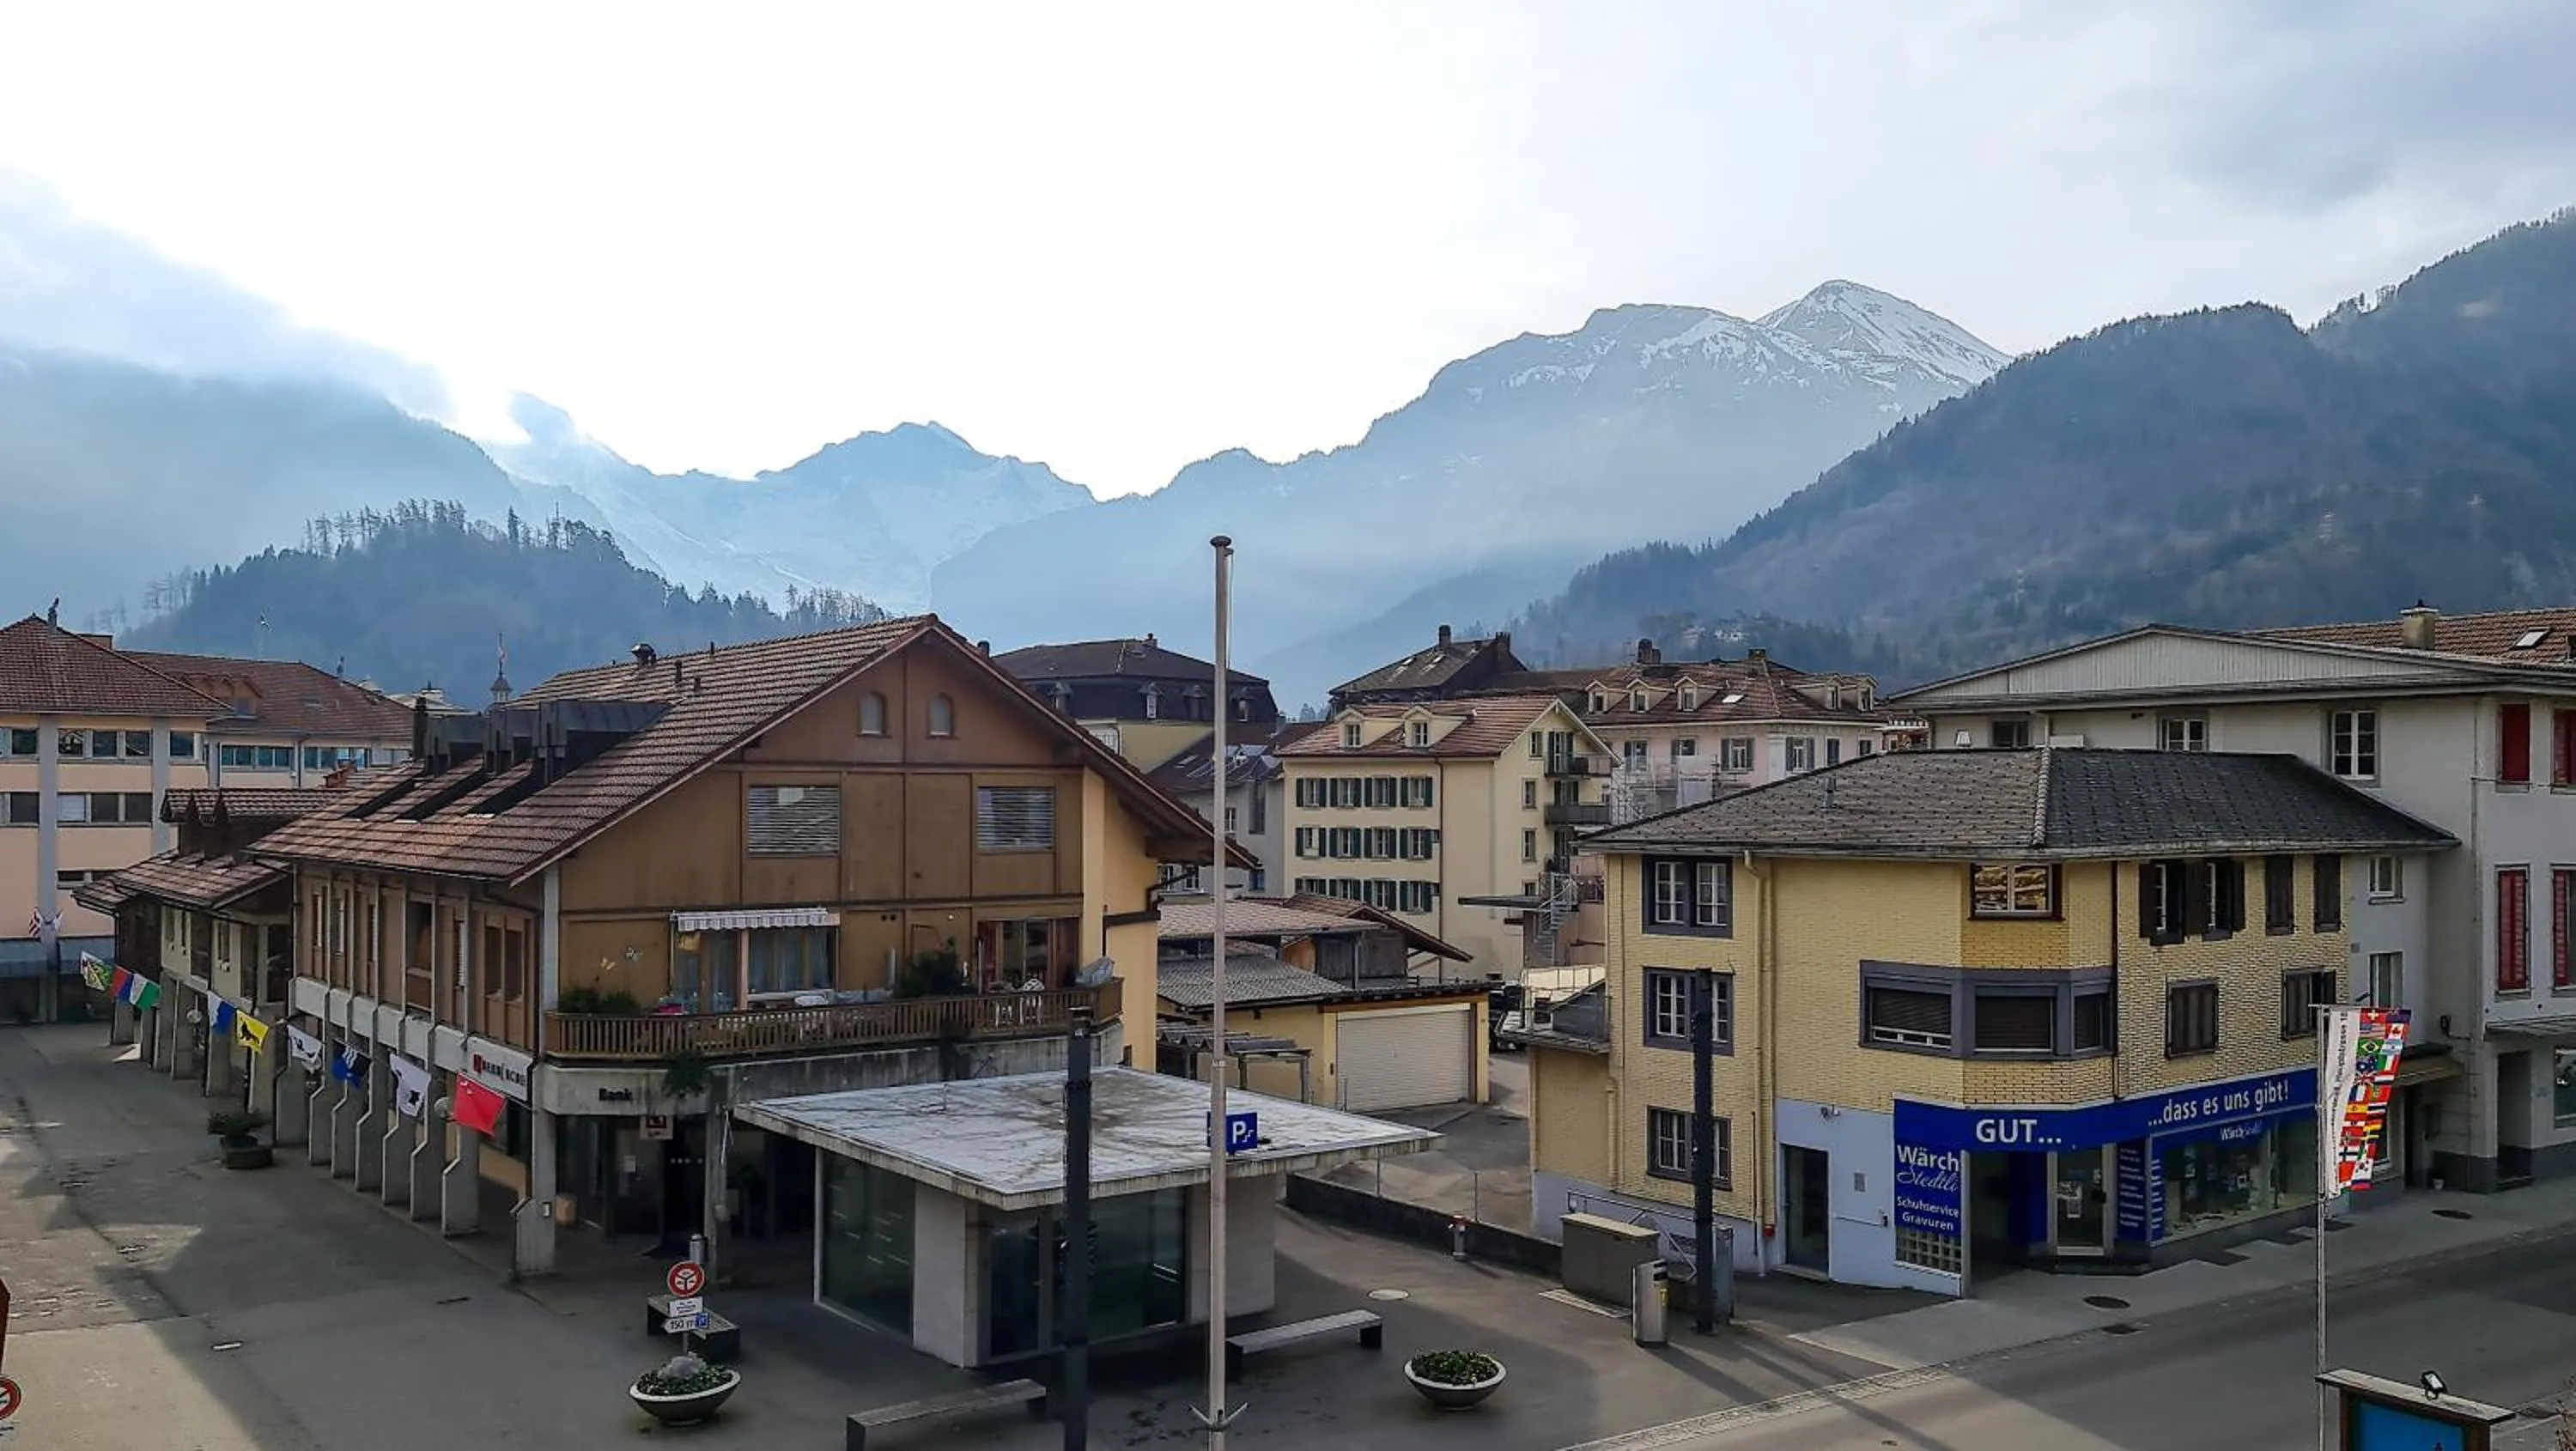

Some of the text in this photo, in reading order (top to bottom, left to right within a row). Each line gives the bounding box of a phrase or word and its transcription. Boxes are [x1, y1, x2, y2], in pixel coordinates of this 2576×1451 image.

[2202, 1096, 2219, 1115] es
[2224, 1090, 2251, 1111] uns
[2254, 1079, 2288, 1112] gibt!
[1232, 1120, 1247, 1144] P
[1976, 1119, 2063, 1144] GUT...
[1897, 1144, 1959, 1172] Wärch
[1897, 1196, 1959, 1218] Schuhservice
[1902, 1211, 1954, 1232] Gravuren
